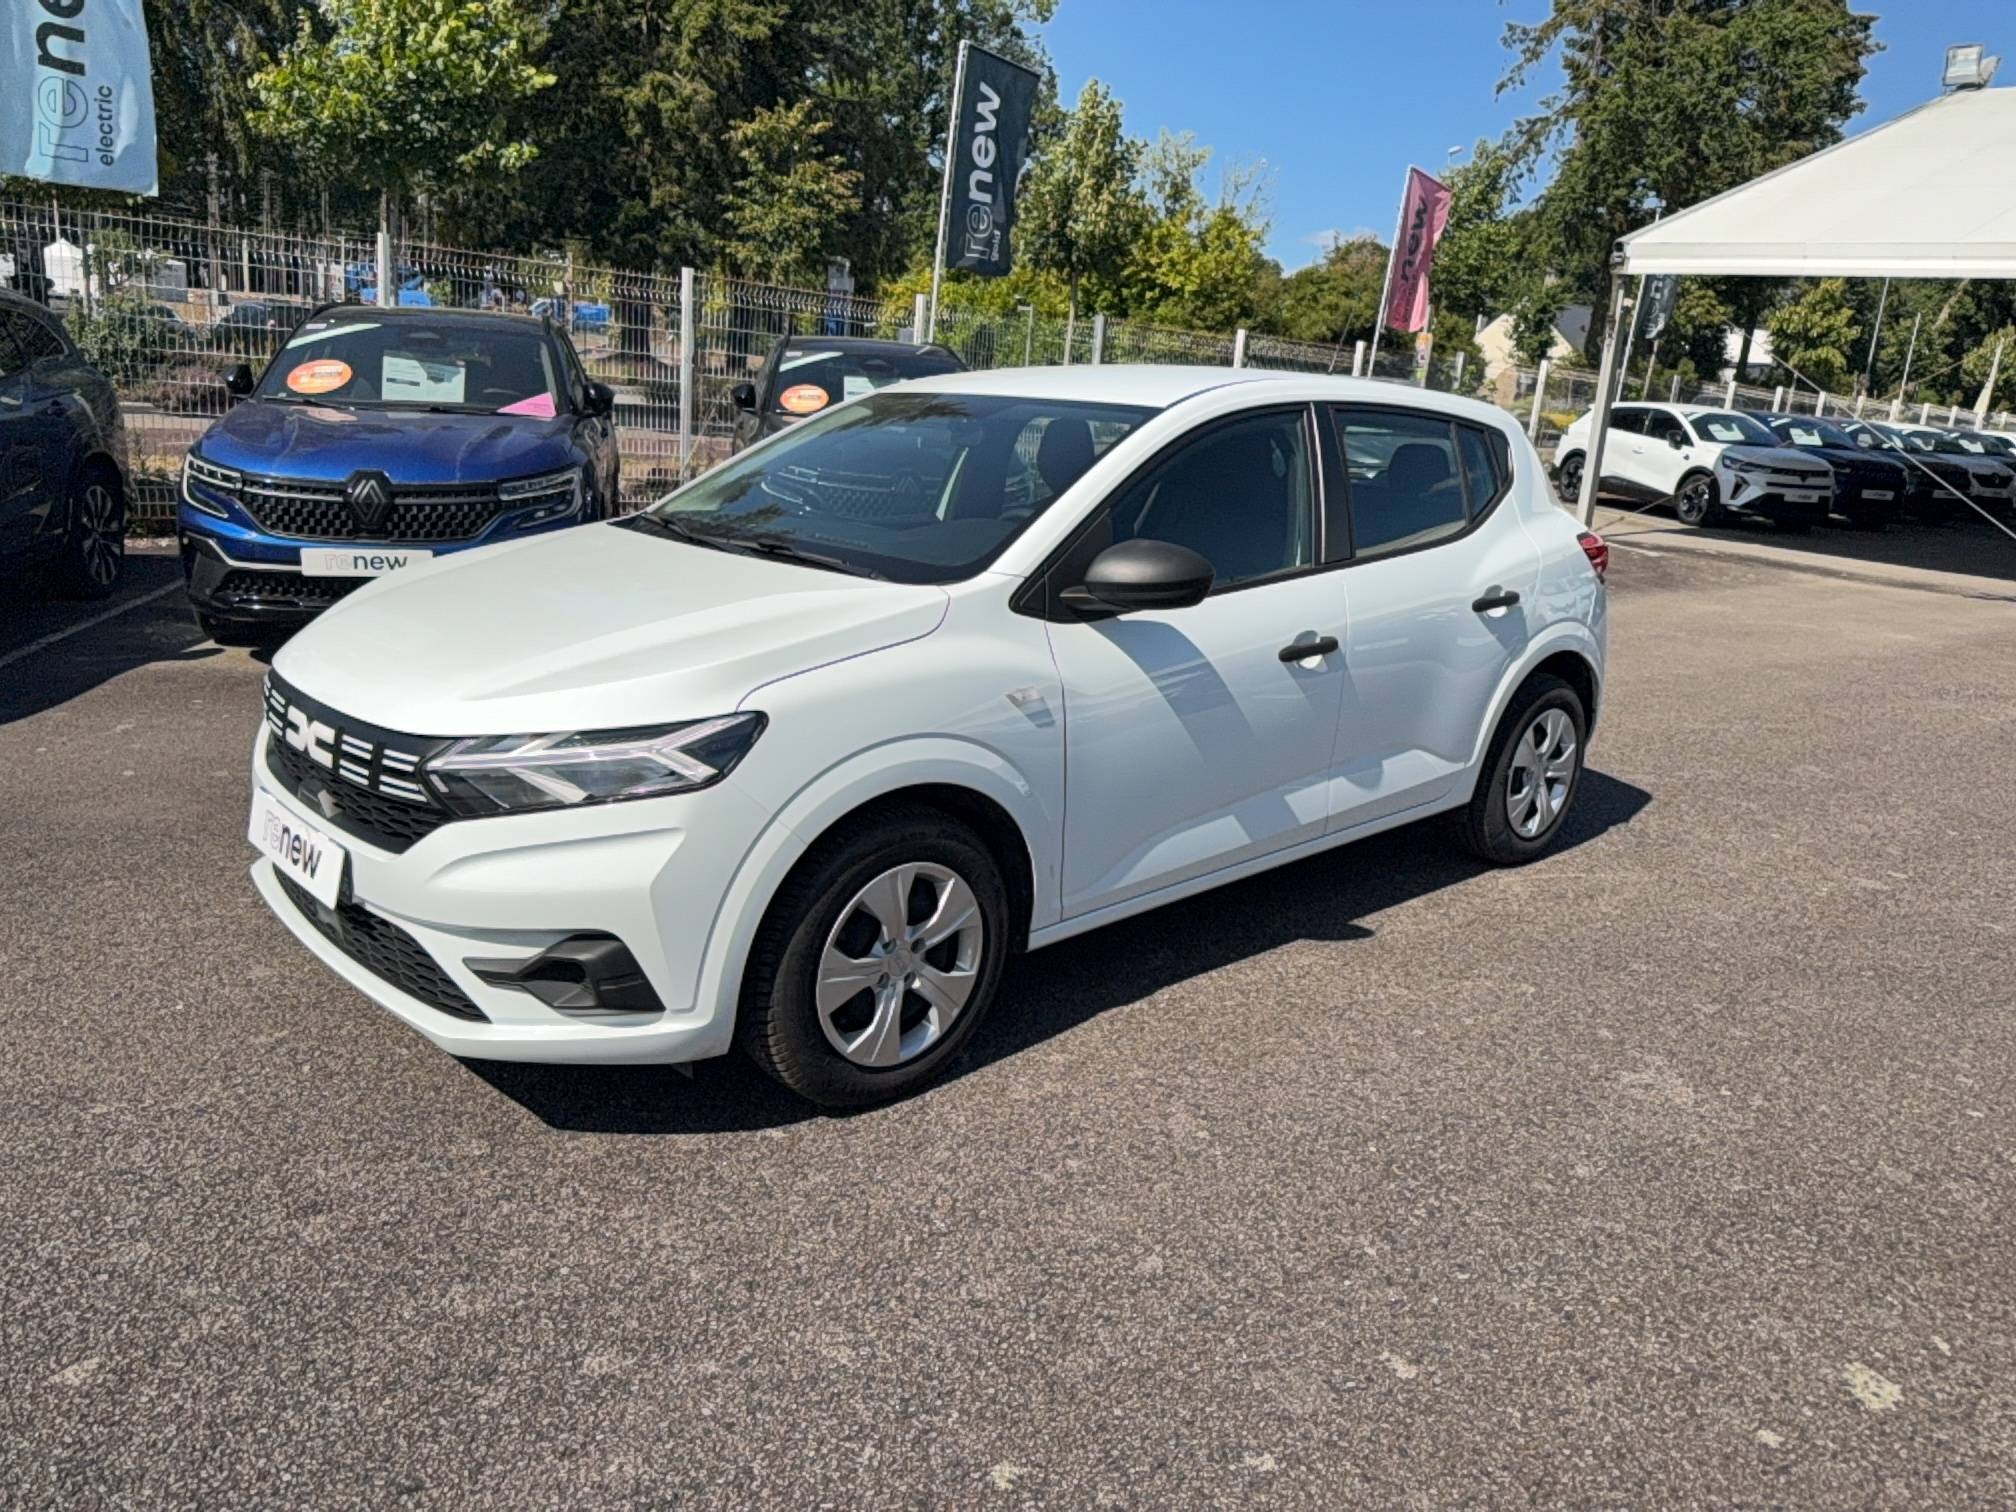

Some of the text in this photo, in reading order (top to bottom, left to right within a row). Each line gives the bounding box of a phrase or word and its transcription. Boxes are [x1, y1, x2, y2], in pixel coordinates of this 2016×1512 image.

[94, 85, 115, 167] electric
[964, 82, 1001, 260] renew
[262, 809, 322, 879] renew
